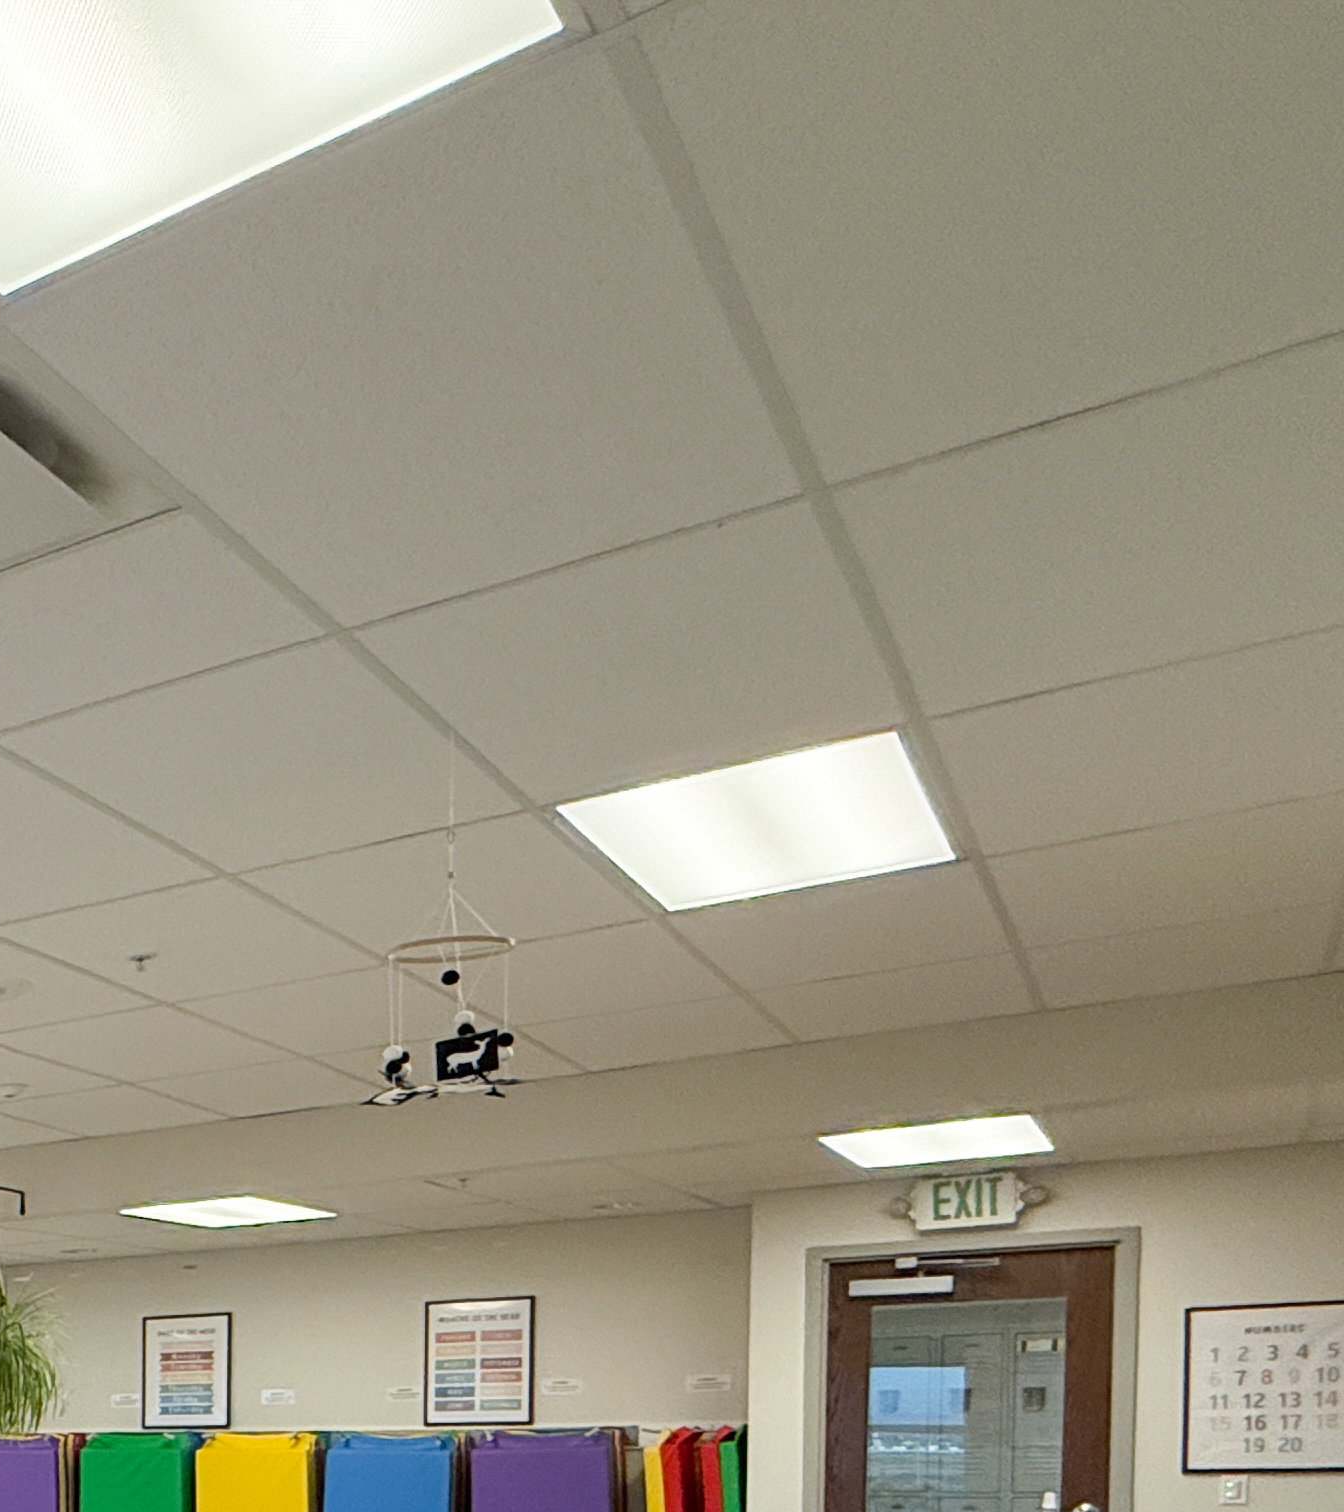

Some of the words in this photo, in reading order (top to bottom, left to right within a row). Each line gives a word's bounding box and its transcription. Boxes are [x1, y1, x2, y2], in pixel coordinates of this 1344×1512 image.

[933, 1175, 1003, 1221] EXIT
[1244, 1323, 1306, 1335] NUMBERS
[1211, 1347, 1218, 1363] 1
[1238, 1346, 1249, 1362] 2
[1267, 1345, 1279, 1361] 3
[1296, 1344, 1309, 1359] 4
[1327, 1342, 1340, 1359] 5
[1234, 1370, 1247, 1386] 7
[1261, 1369, 1274, 1385] 8
[1317, 1367, 1340, 1383] 10
[1210, 1393, 1229, 1410] 11
[1243, 1393, 1266, 1409] 12
[1279, 1391, 1302, 1408] 13
[1314, 1390, 1338, 1407] 14
[1243, 1415, 1267, 1431] 16
[1280, 1414, 1303, 1430] 17
[1316, 1413, 1339, 1429] 18
[1243, 1437, 1266, 1454] 19
[1278, 1436, 1303, 1453] 20
